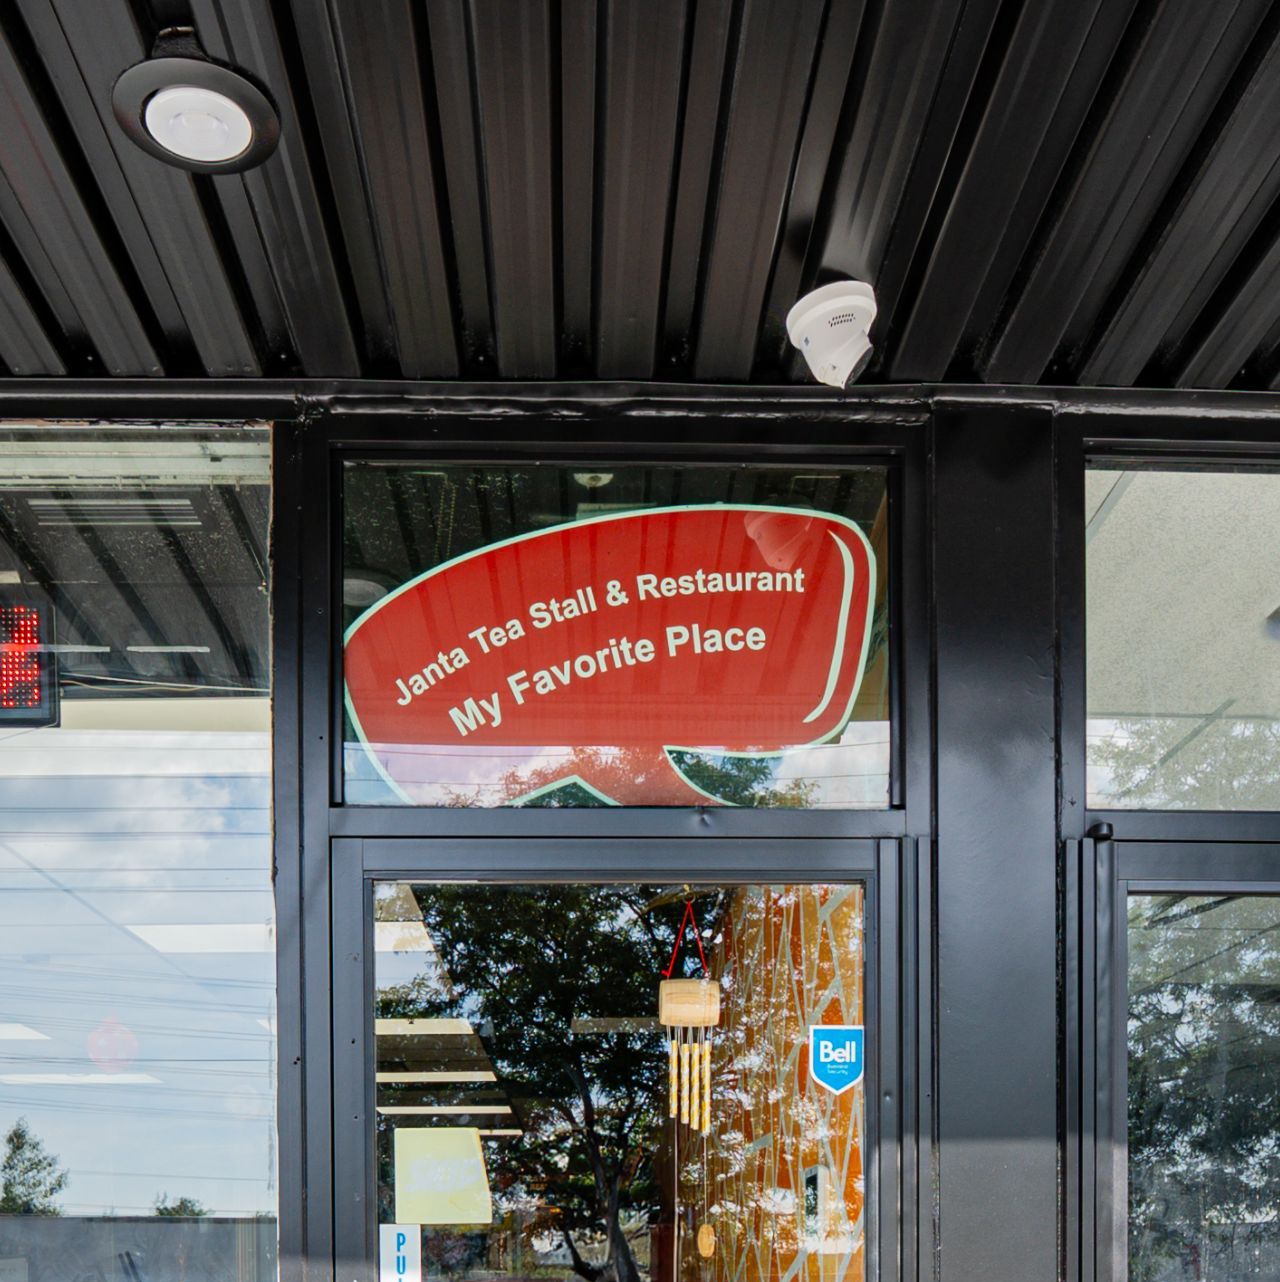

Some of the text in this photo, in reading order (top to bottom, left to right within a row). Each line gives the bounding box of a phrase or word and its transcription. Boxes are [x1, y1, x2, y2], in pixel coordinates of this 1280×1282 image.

[396, 567, 806, 707] Janta Tea Stall & Restaurant
[448, 623, 767, 737] My Favorite Place
[819, 1040, 857, 1063] Bell
